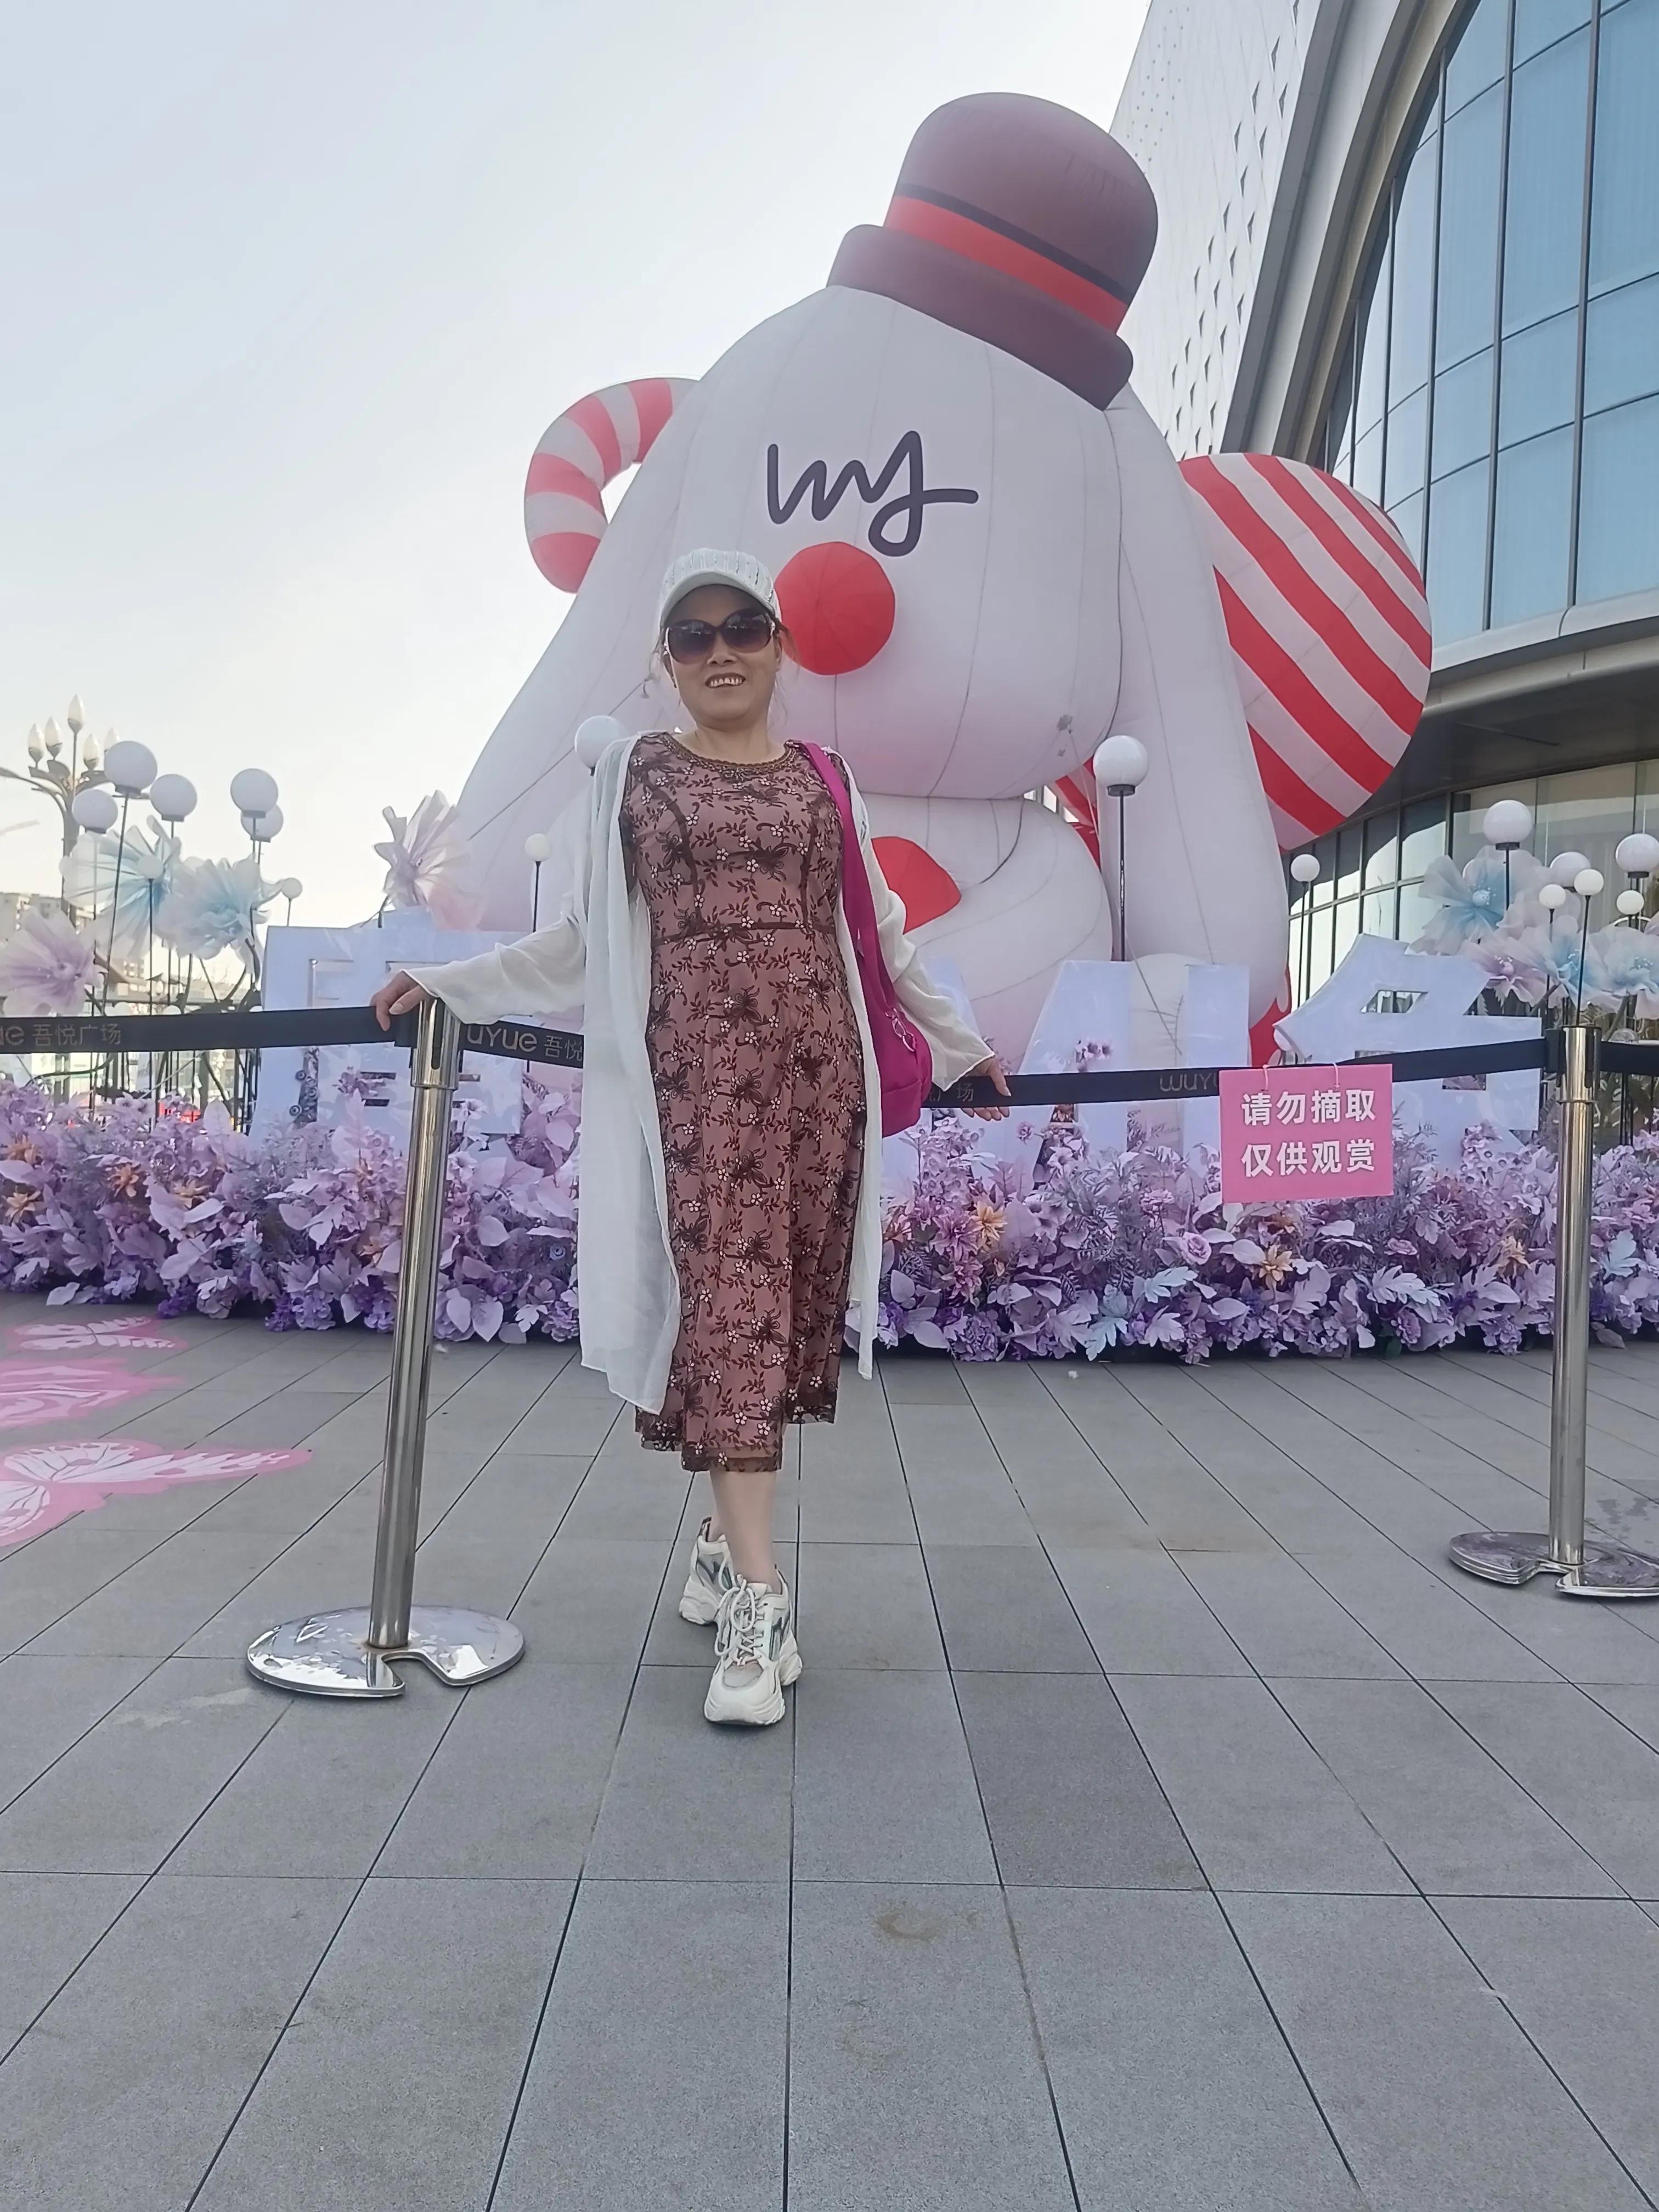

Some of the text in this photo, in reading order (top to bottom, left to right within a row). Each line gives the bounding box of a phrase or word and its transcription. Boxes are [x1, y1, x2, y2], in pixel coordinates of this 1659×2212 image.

[32, 1024, 121, 1046] 吾悦广场
[1241, 1089, 1376, 1126] 请勿摘取
[1241, 1138, 1376, 1178] 仅供观赏
